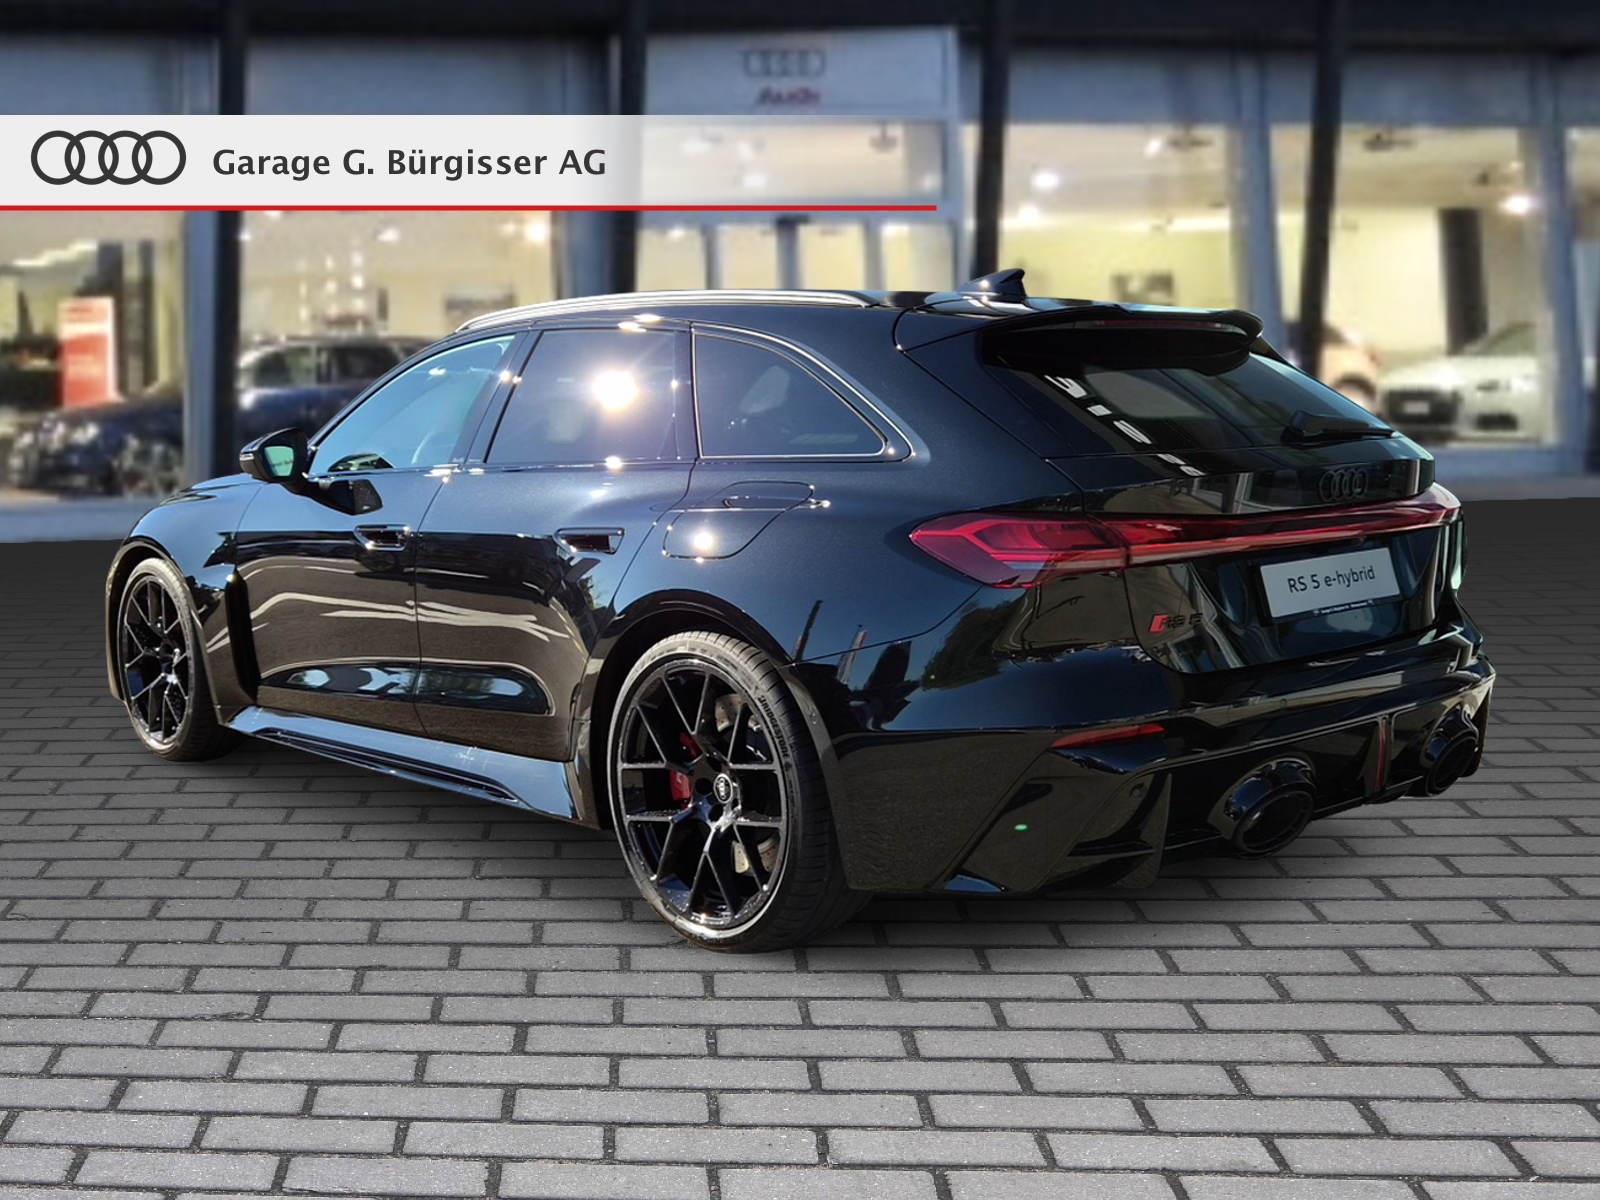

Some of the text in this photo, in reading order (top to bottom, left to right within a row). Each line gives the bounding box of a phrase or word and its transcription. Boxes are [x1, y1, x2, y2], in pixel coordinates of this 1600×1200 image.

[1287, 565, 1375, 593] RS 5 e-hybrid
